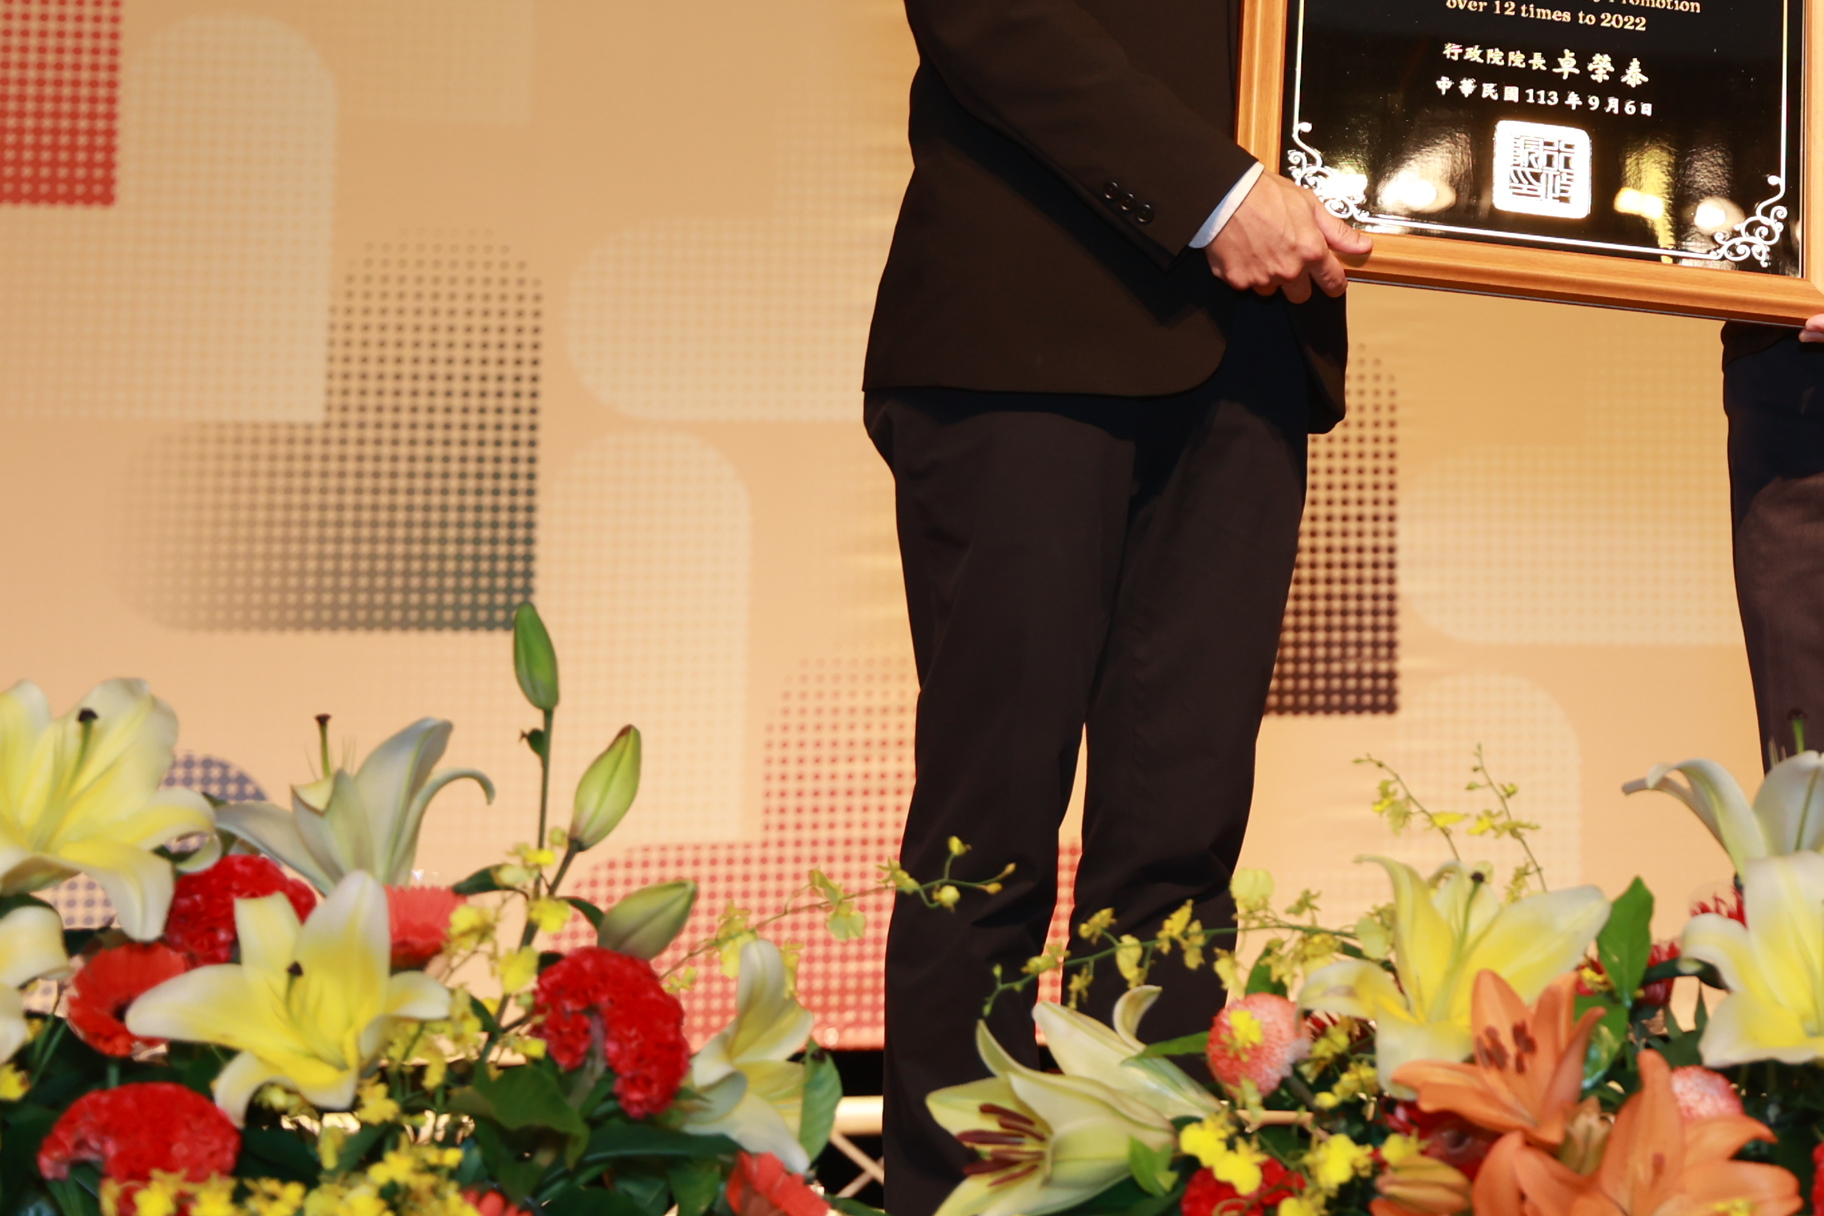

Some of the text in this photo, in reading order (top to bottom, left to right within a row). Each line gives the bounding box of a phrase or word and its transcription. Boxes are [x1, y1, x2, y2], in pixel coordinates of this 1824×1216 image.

[1493, 0, 1515, 16] 12
[1520, 3, 1571, 23] times
[1578, 10, 1596, 26] to
[1600, 13, 1647, 31] 2022
